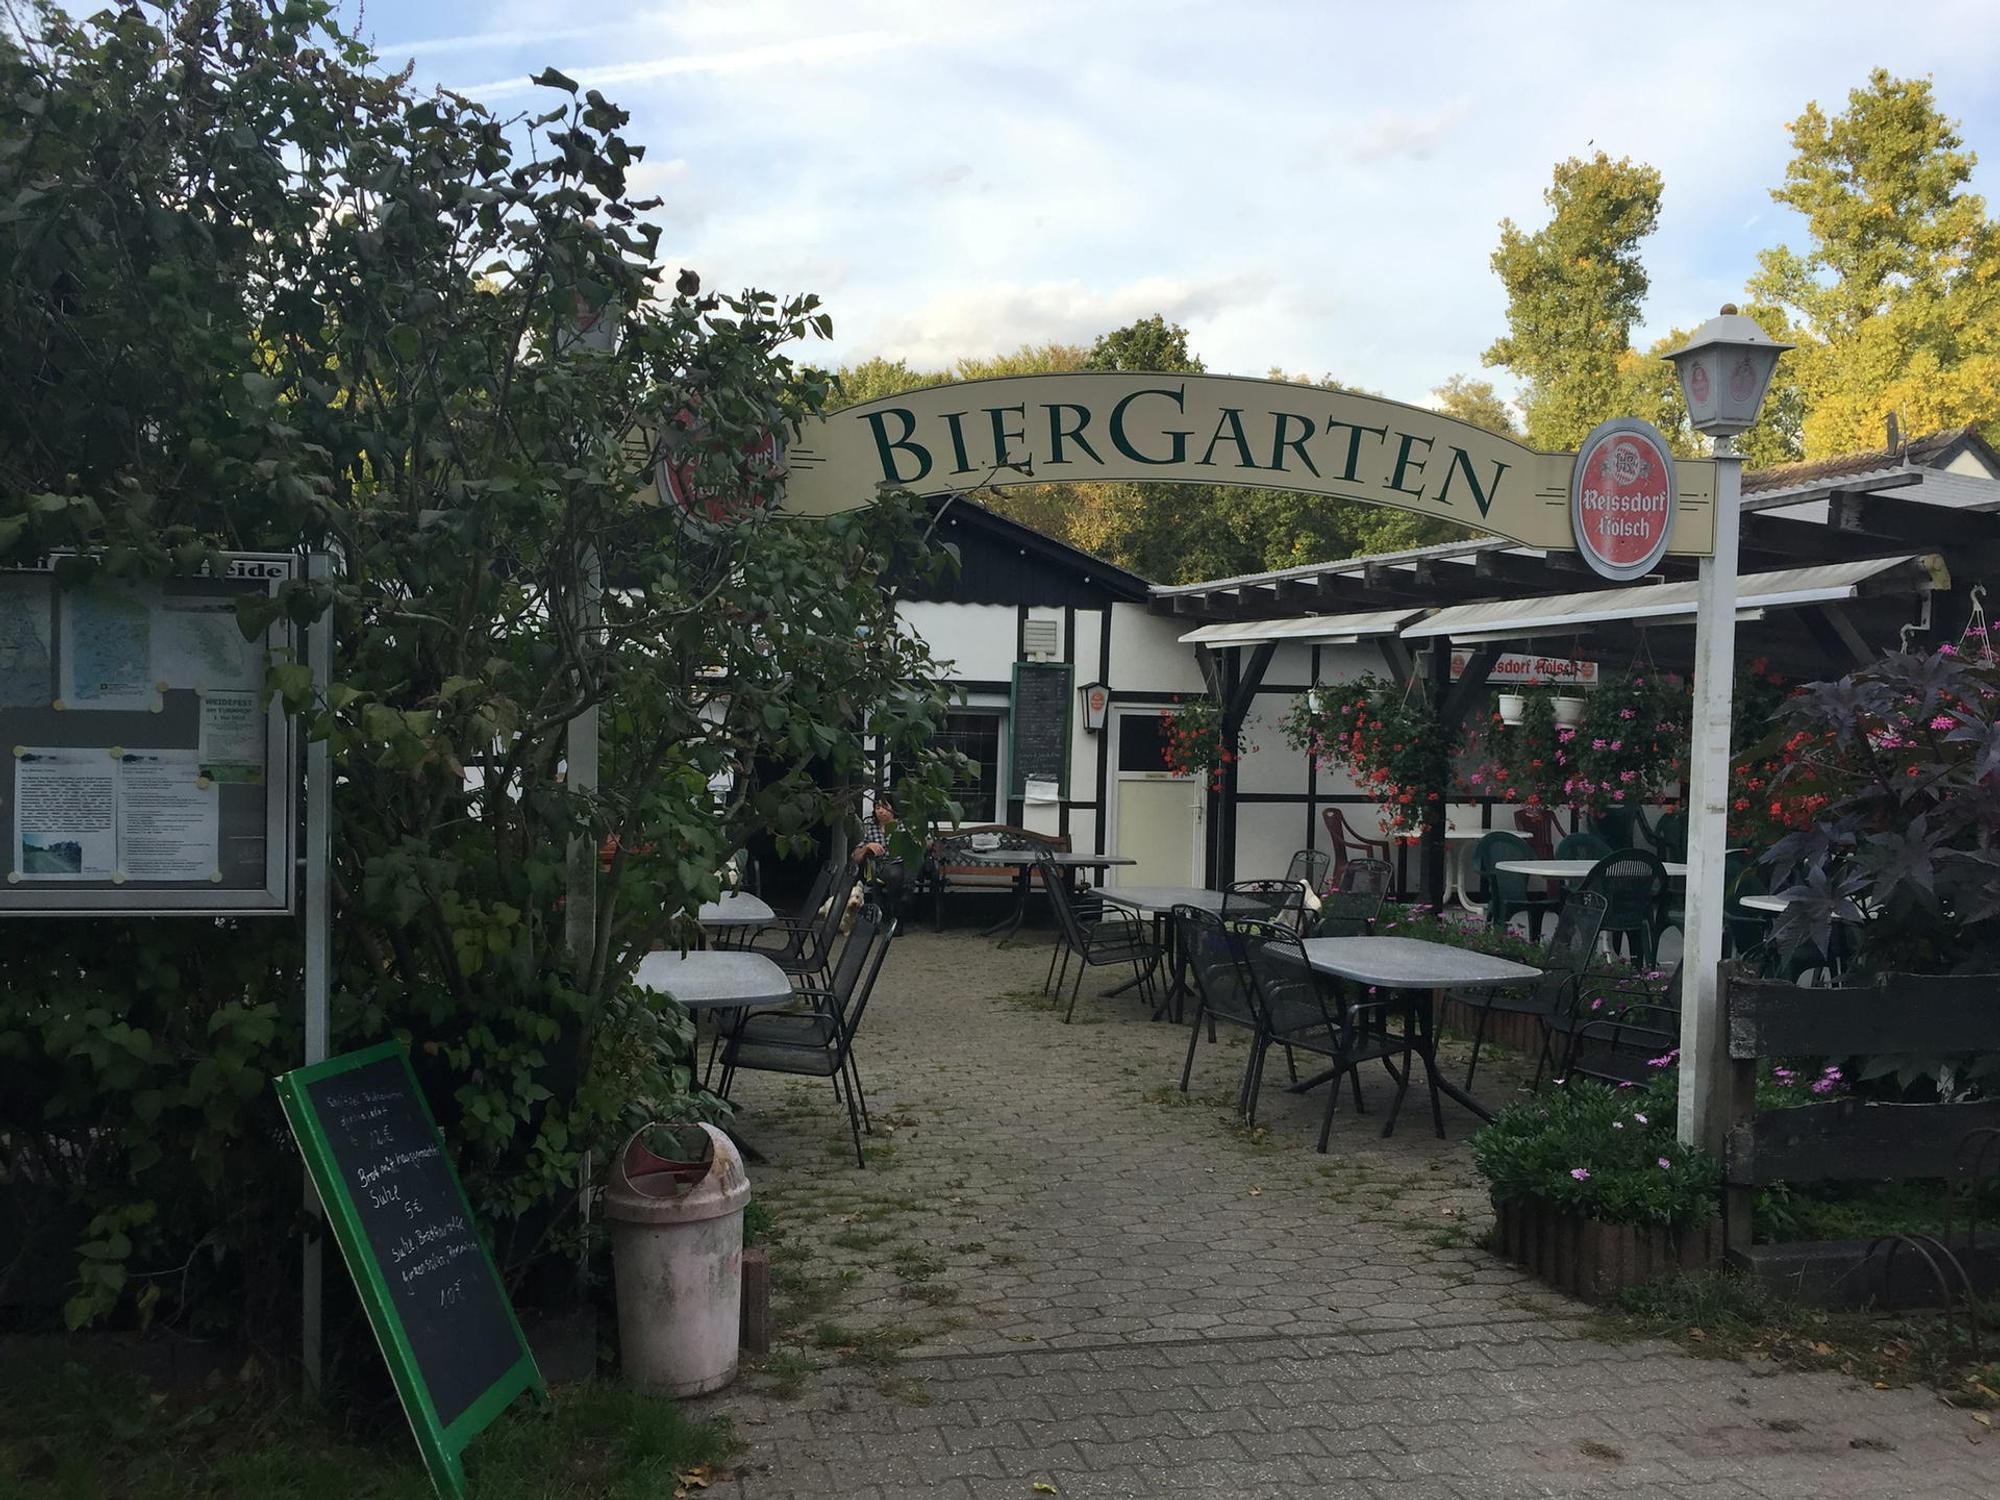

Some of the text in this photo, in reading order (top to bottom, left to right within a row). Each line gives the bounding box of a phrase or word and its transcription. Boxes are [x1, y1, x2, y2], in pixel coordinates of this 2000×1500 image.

[1583, 489, 1669, 512] Reissdorf
[1599, 515, 1650, 540] Kölsch
[225, 562, 283, 578] eide
[1490, 658, 1531, 674] ssdorf
